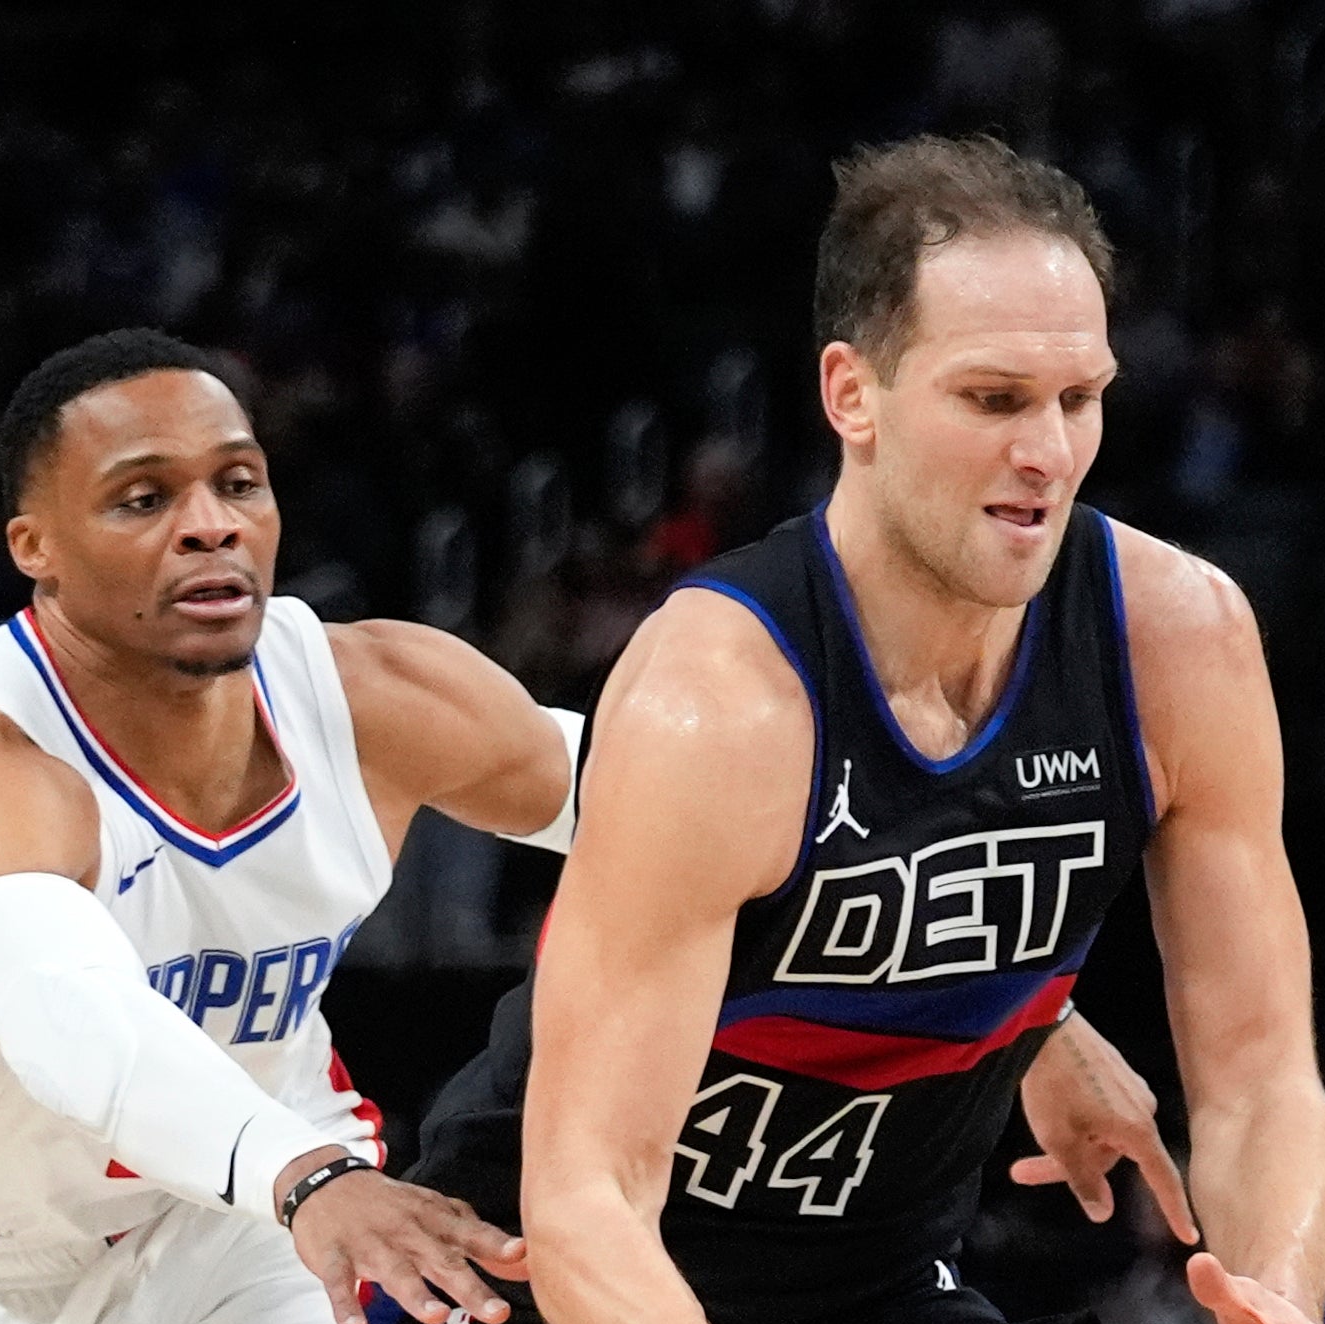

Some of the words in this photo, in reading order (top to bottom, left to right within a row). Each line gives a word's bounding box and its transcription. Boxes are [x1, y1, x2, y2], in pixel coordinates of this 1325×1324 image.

[1015, 747, 1101, 789] UWM
[773, 820, 1105, 984] DET
[147, 914, 363, 1045] PPER
[674, 1072, 893, 1217] 44
